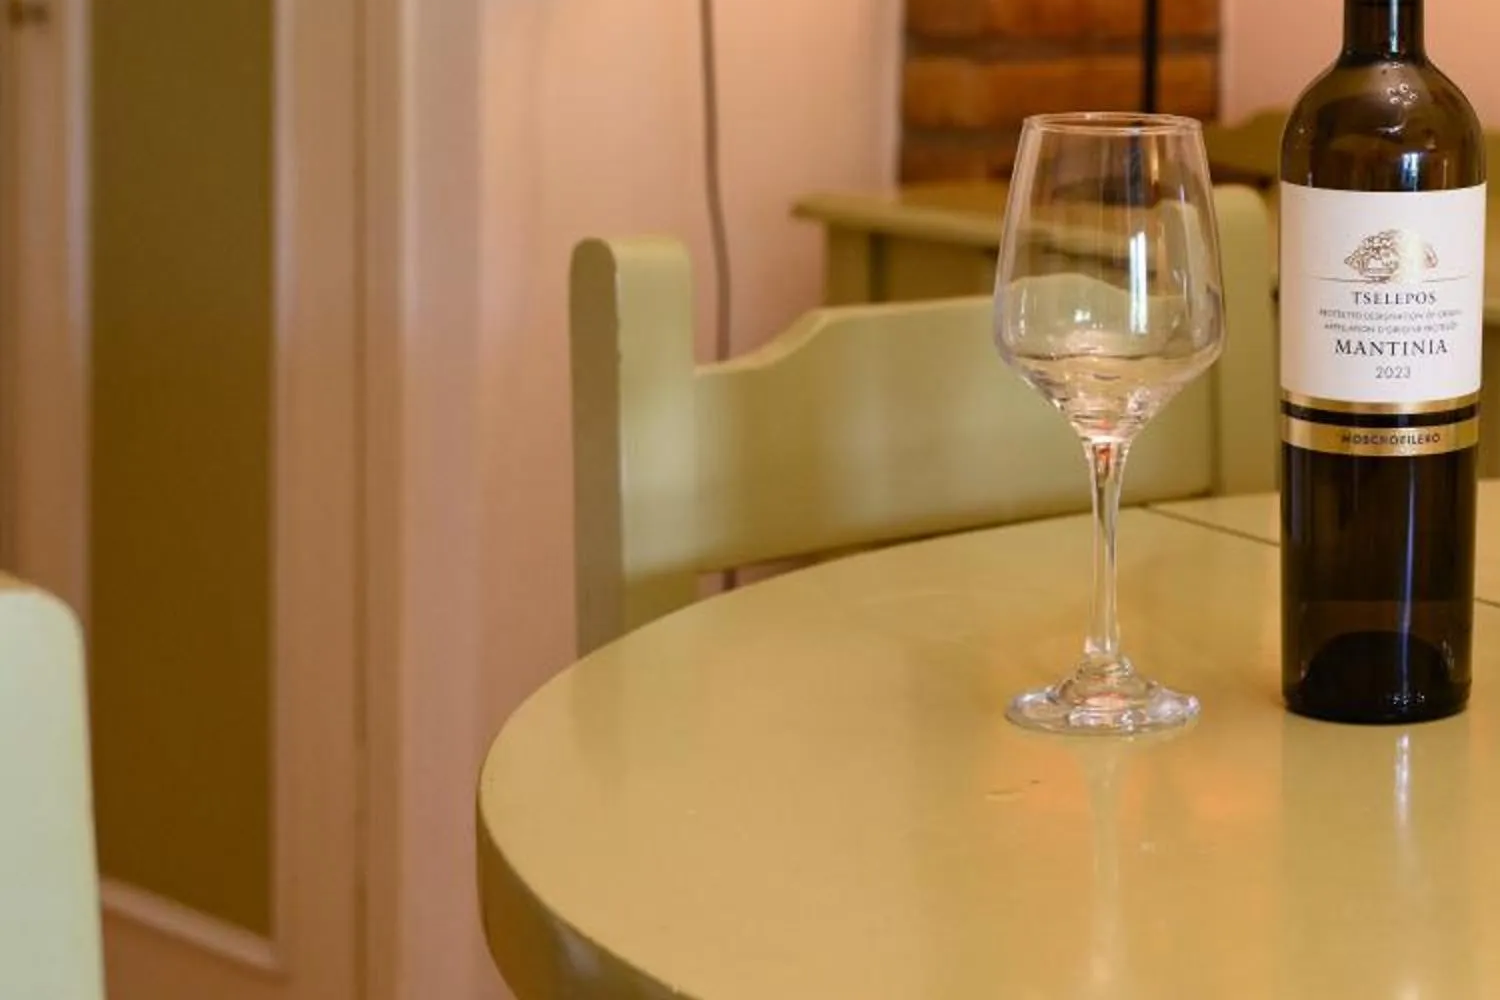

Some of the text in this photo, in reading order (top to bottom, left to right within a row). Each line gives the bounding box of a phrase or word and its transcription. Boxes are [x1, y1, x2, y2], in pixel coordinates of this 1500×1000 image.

[1351, 291, 1437, 306] TSELEPOS
[1335, 338, 1448, 357] MANTINIA
[1375, 365, 1411, 379] 2023
